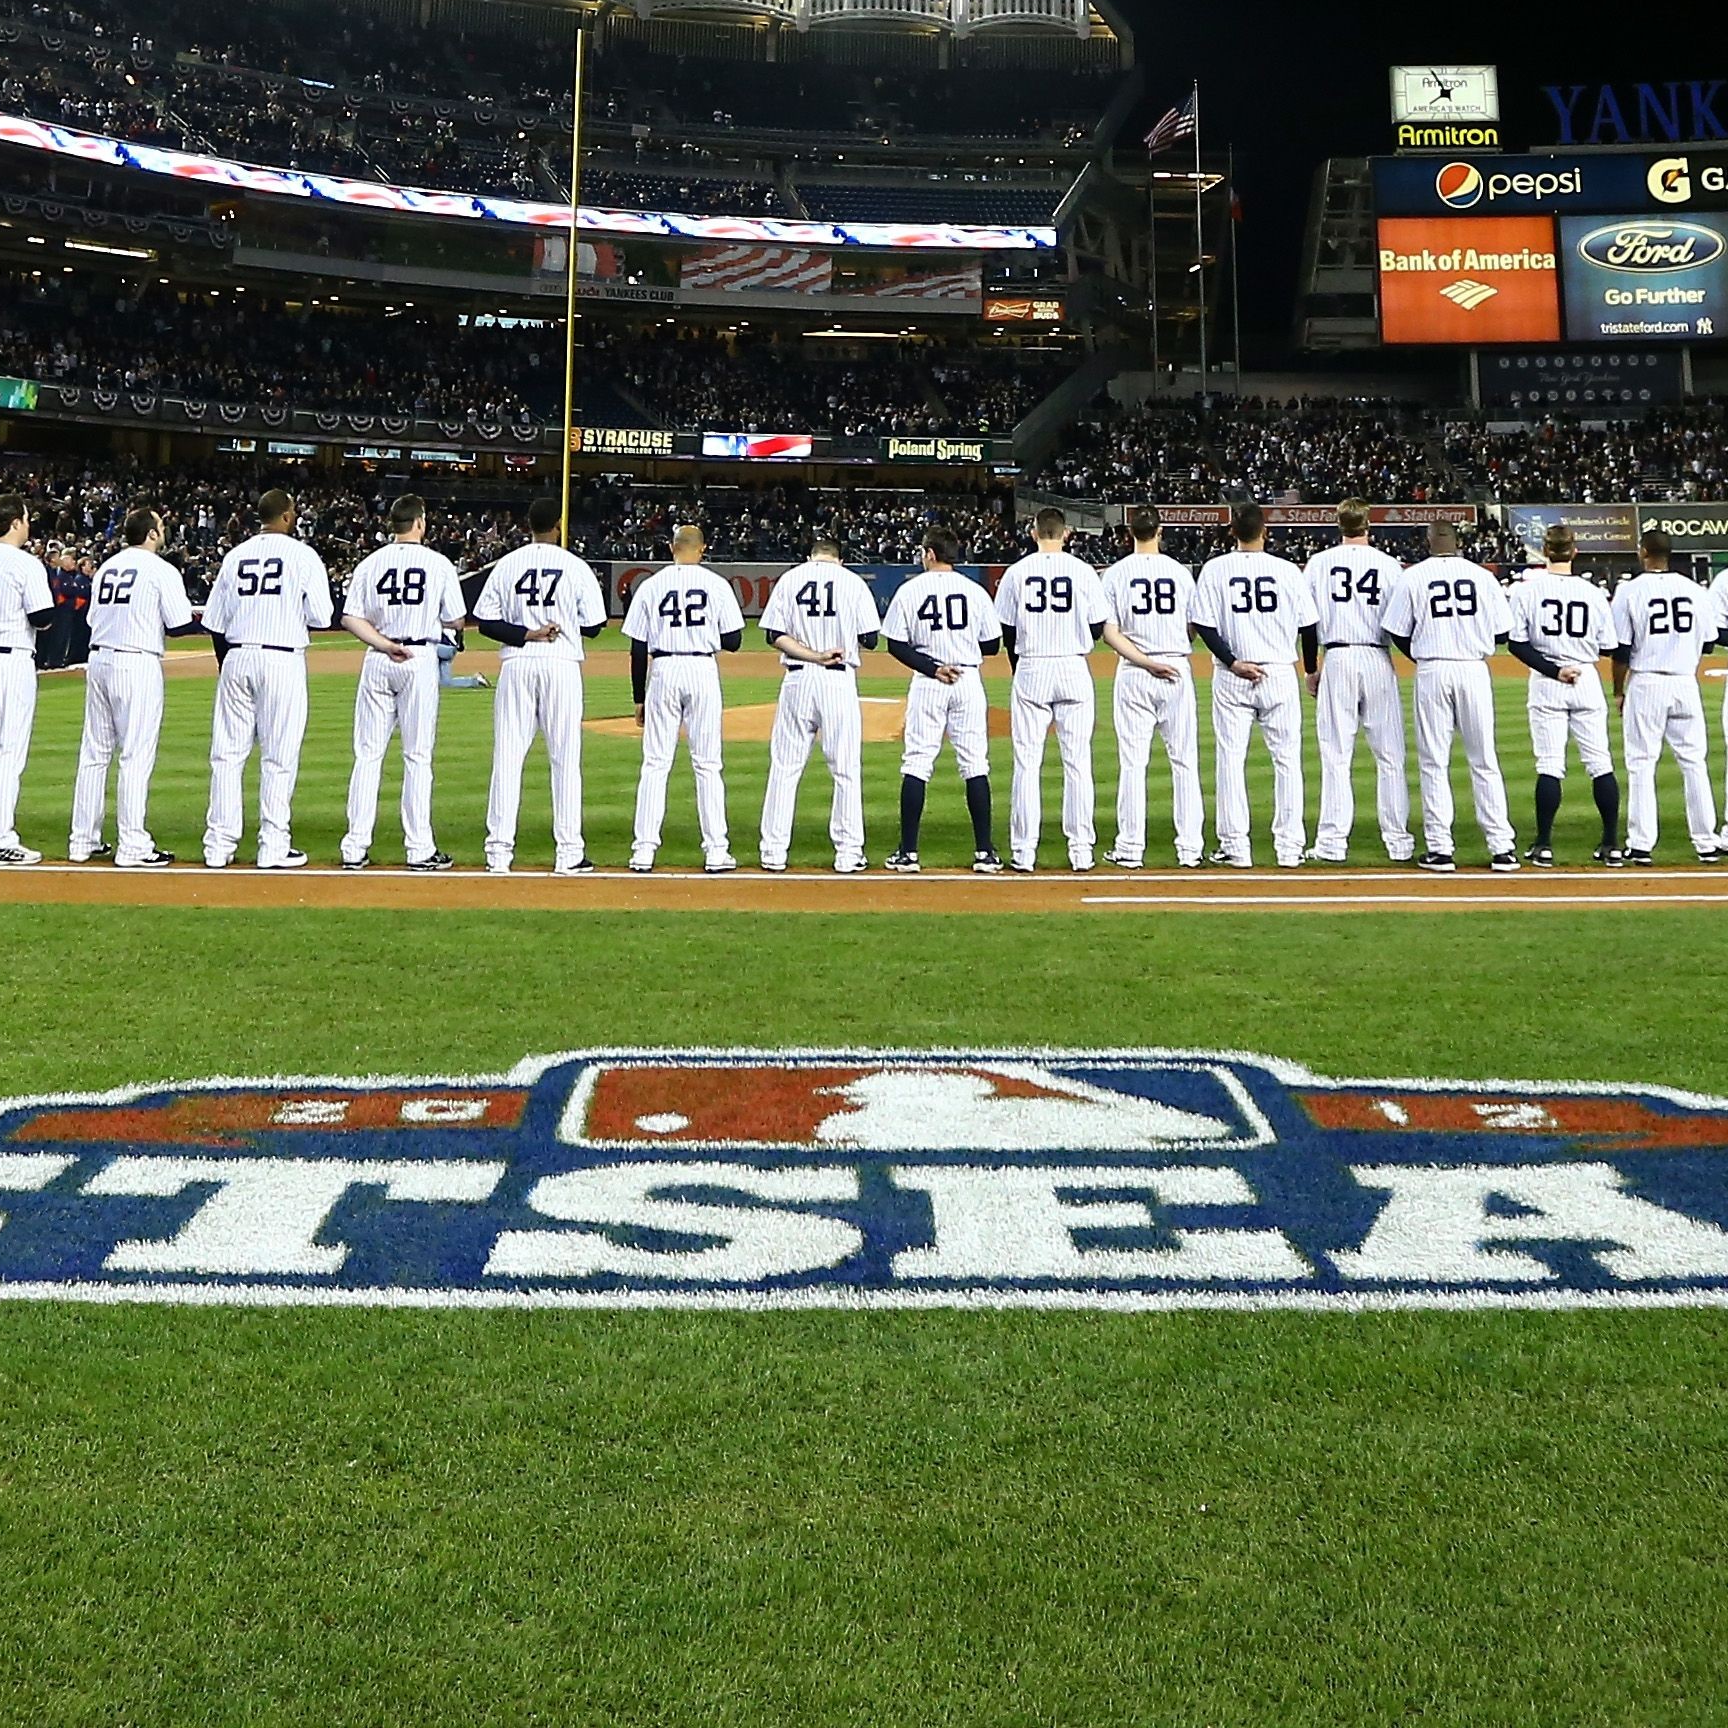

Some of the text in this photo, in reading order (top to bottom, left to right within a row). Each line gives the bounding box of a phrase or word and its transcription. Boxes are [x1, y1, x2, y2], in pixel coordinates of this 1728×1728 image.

[1398, 126, 1498, 145] Armitron
[1489, 168, 1581, 199] pepsi
[1380, 248, 1555, 272] Bank of America
[1607, 228, 1695, 264] Ford
[650, 291, 675, 301] CLUB
[1605, 287, 1706, 305] Go Further
[1601, 321, 1689, 334] tristateford.com
[583, 429, 673, 447] SYRACUSE
[889, 439, 982, 461] Poland Spring
[98, 570, 135, 604] 62
[238, 558, 282, 596] 52
[376, 568, 425, 605] 48
[515, 569, 563, 607] 47
[1025, 577, 1072, 612] 39
[1331, 567, 1380, 605] 34
[659, 590, 707, 627] 42
[796, 581, 836, 616] 41
[917, 594, 968, 631] 40
[1130, 579, 1175, 614] 38
[1229, 577, 1277, 613] 36
[1428, 580, 1477, 618] 29
[1542, 599, 1588, 638] 30
[1649, 597, 1692, 635] 26
